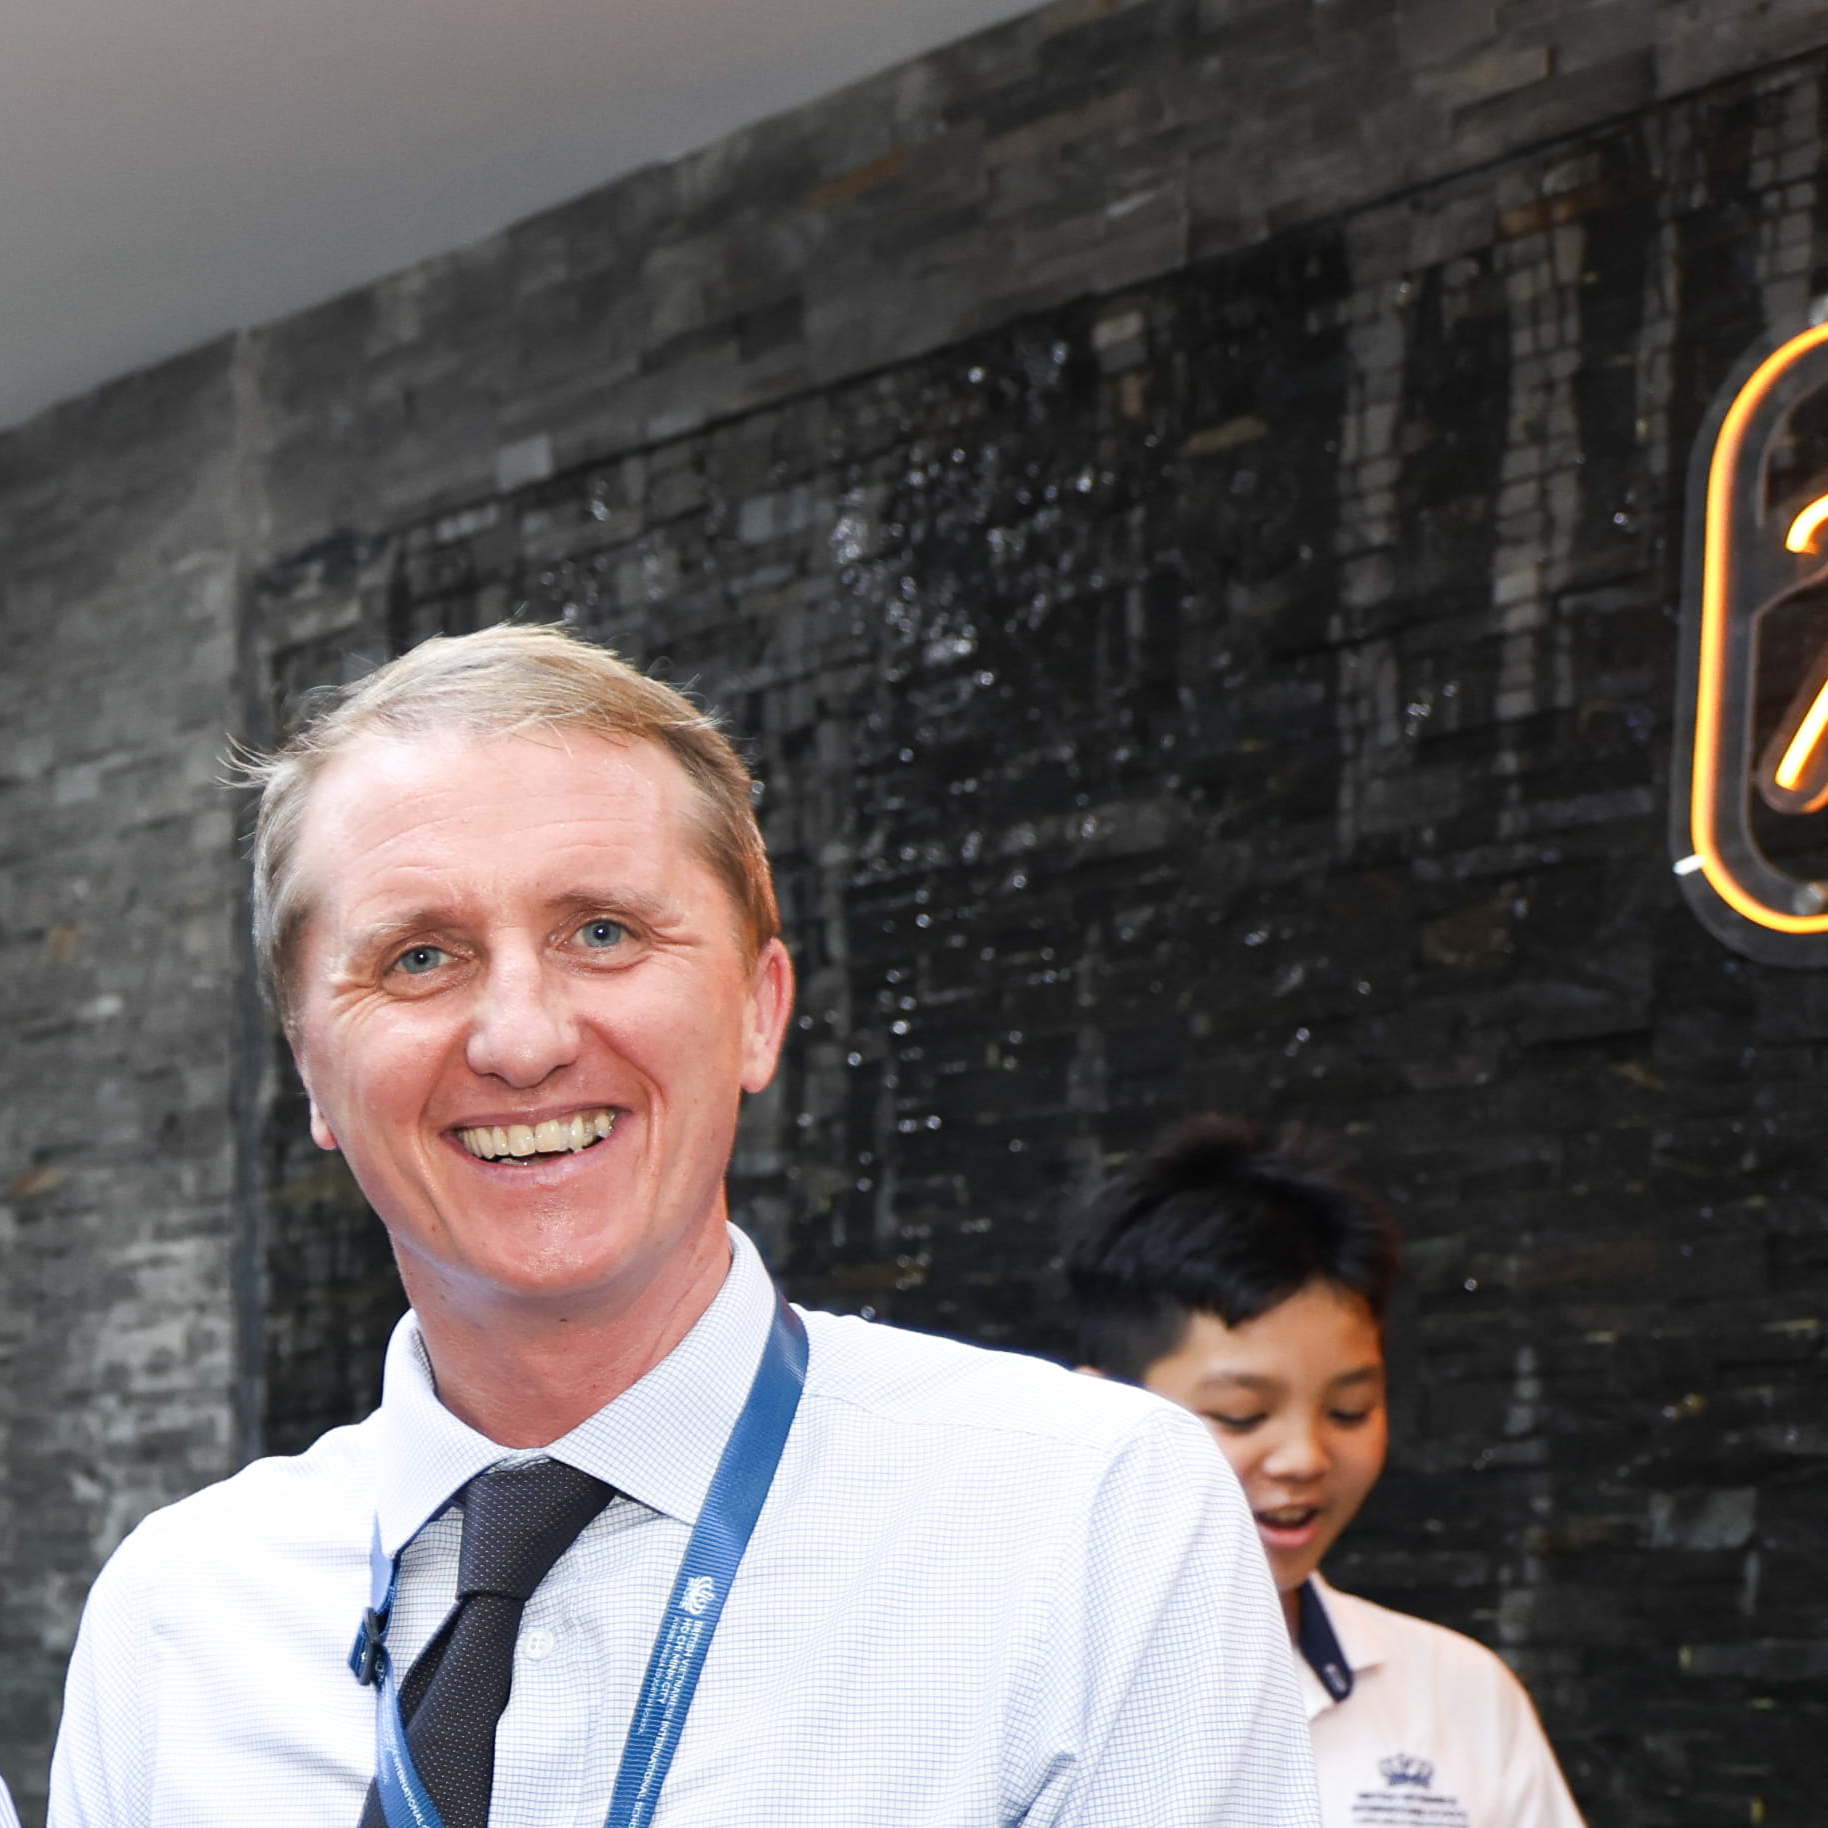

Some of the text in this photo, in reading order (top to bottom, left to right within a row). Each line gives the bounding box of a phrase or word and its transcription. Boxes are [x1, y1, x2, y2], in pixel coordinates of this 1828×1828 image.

[658, 1618, 692, 1704] HO CHI MINH CITY
[636, 1721, 670, 1800] INTERNATIONAL
